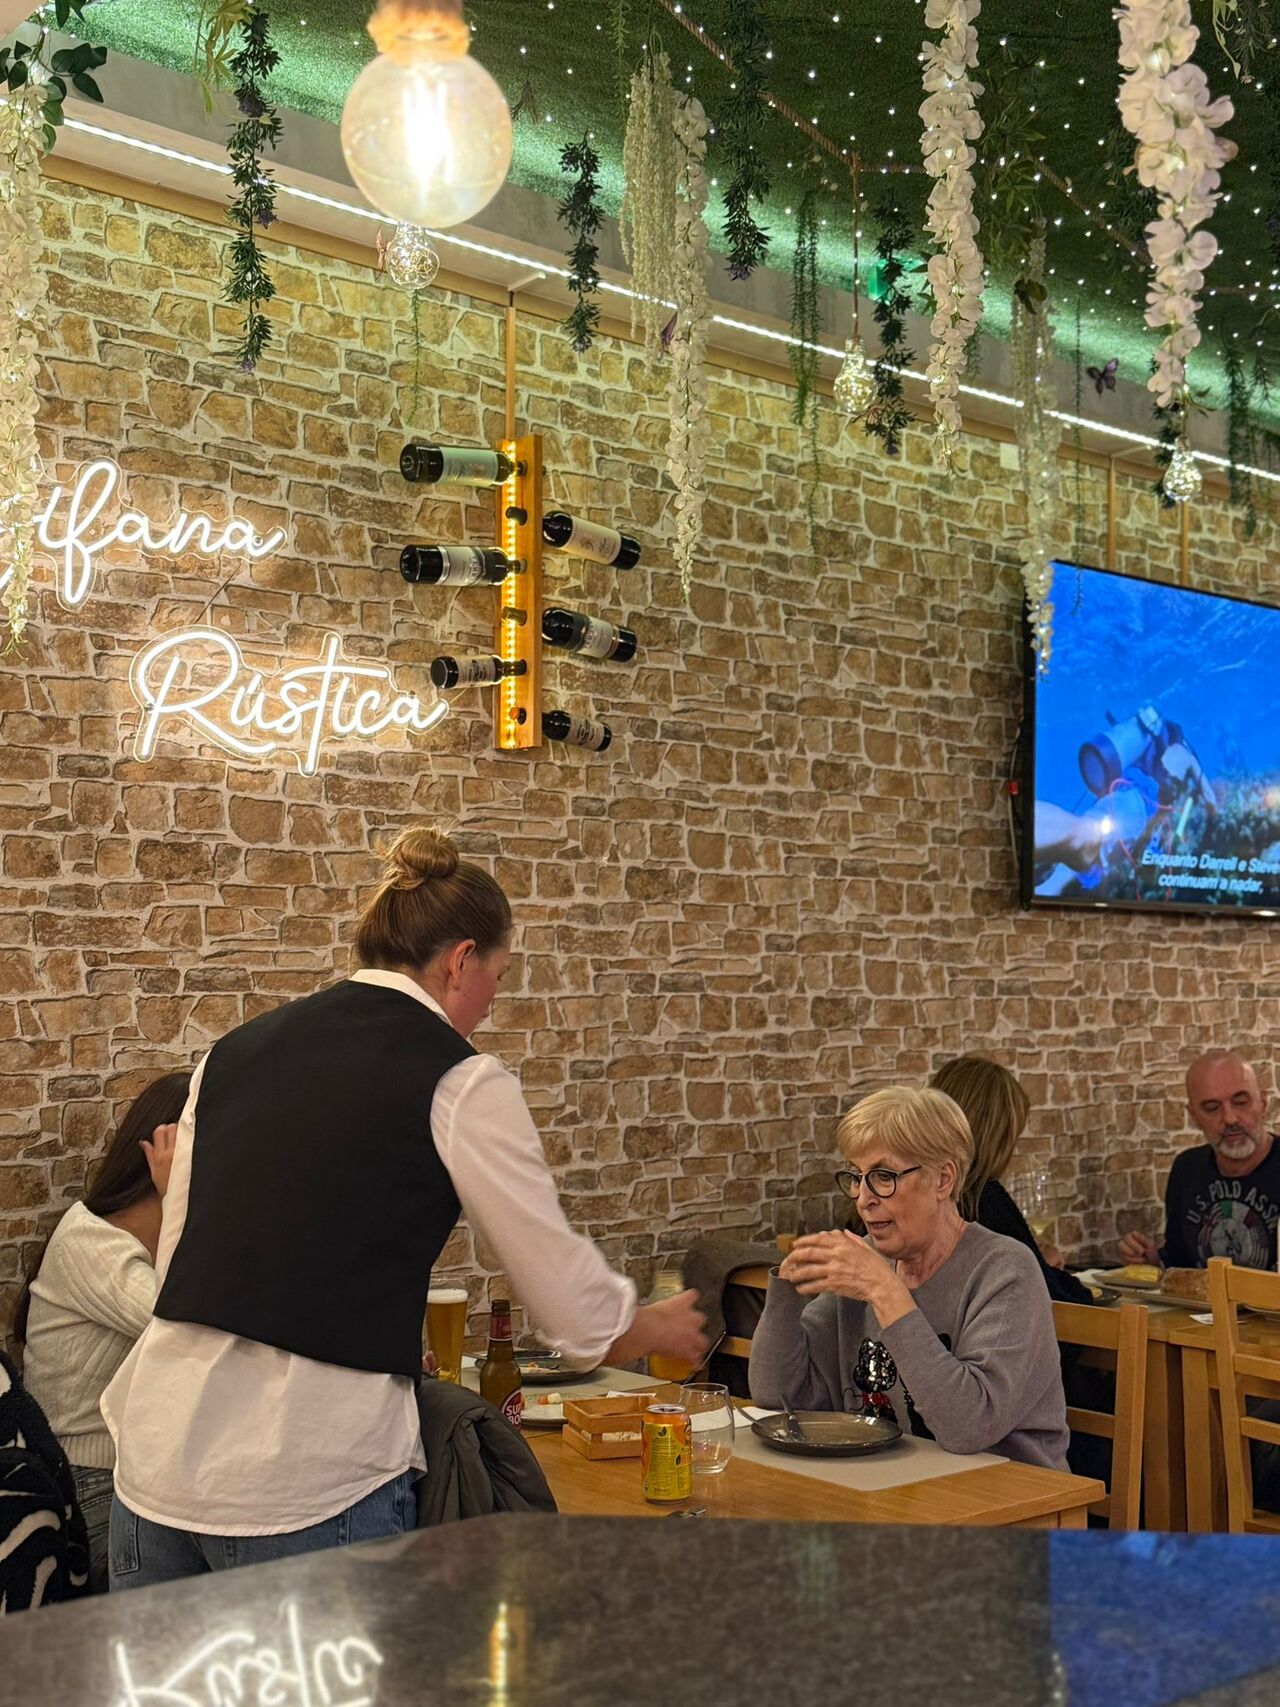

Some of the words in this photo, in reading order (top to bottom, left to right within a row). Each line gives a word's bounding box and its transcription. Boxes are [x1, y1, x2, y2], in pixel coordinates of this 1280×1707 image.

[138, 631, 447, 774] Rústica
[1141, 849, 1198, 869] Enquanto
[1238, 860, 1247, 872] e
[1158, 873, 1218, 889] continuam
[1219, 878, 1229, 890] a
[1208, 1179, 1241, 1202] POLO
